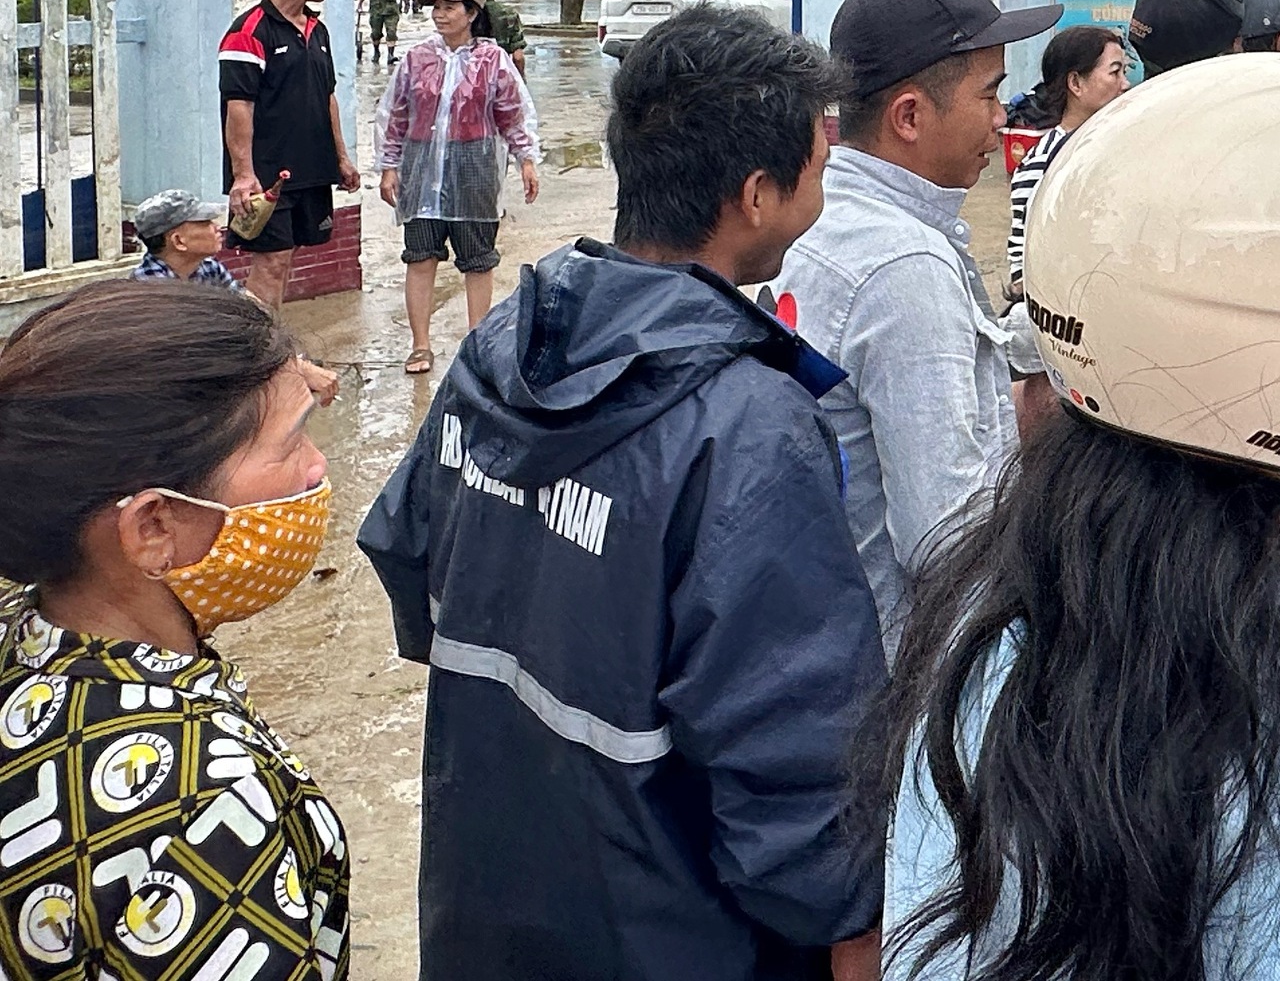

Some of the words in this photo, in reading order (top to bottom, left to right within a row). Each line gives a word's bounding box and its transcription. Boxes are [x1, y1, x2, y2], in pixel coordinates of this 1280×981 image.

[1049, 337, 1097, 369] Vintage
[135, 733, 168, 751] FILA
[136, 753, 173, 801] ITALIA
